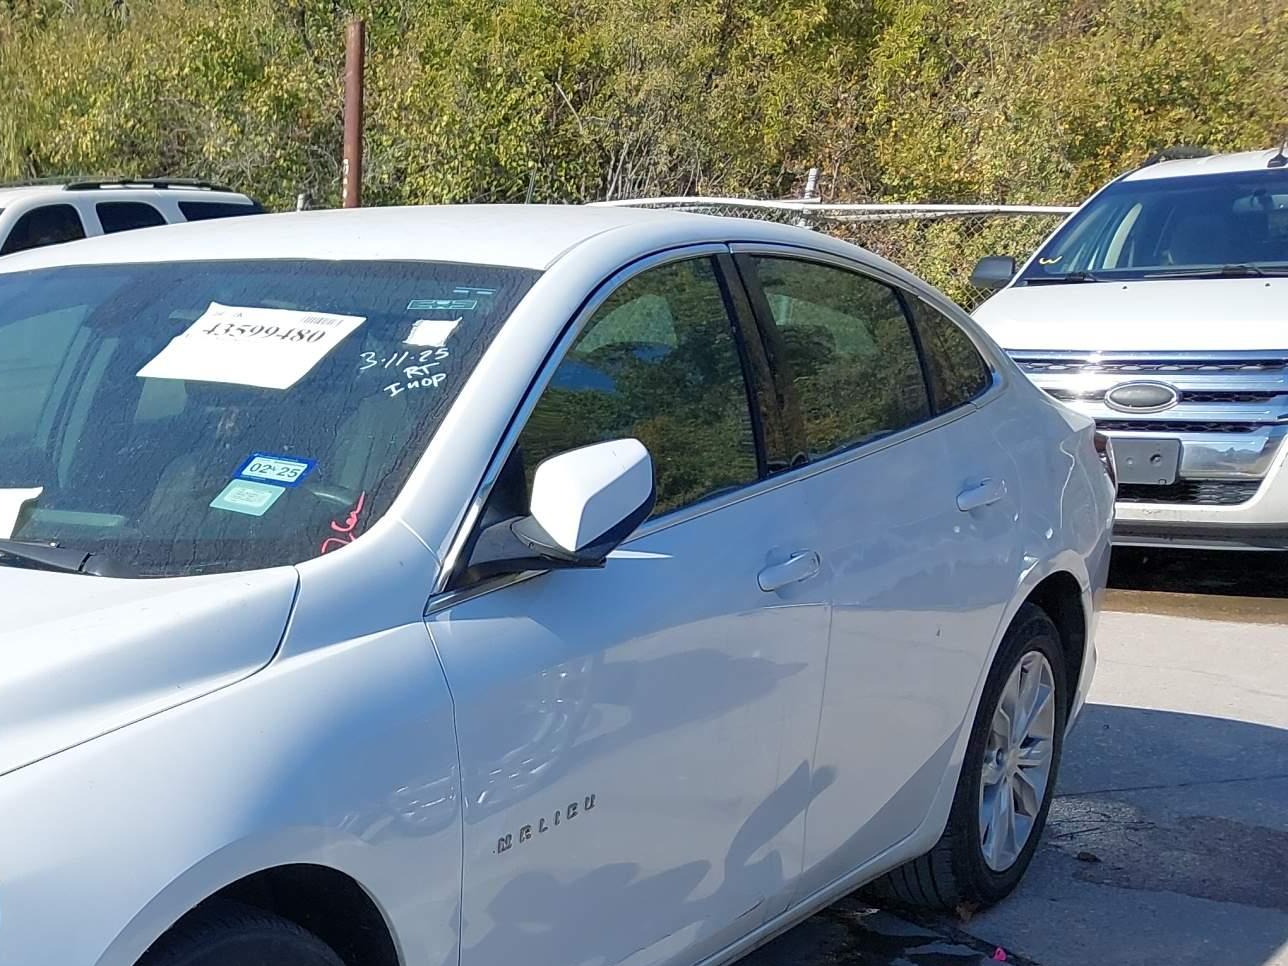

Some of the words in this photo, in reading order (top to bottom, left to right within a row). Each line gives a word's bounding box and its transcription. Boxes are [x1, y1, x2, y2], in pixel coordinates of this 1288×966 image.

[202, 322, 326, 343] 43599480
[249, 462, 269, 474] 02
[277, 466, 301, 478] 25
